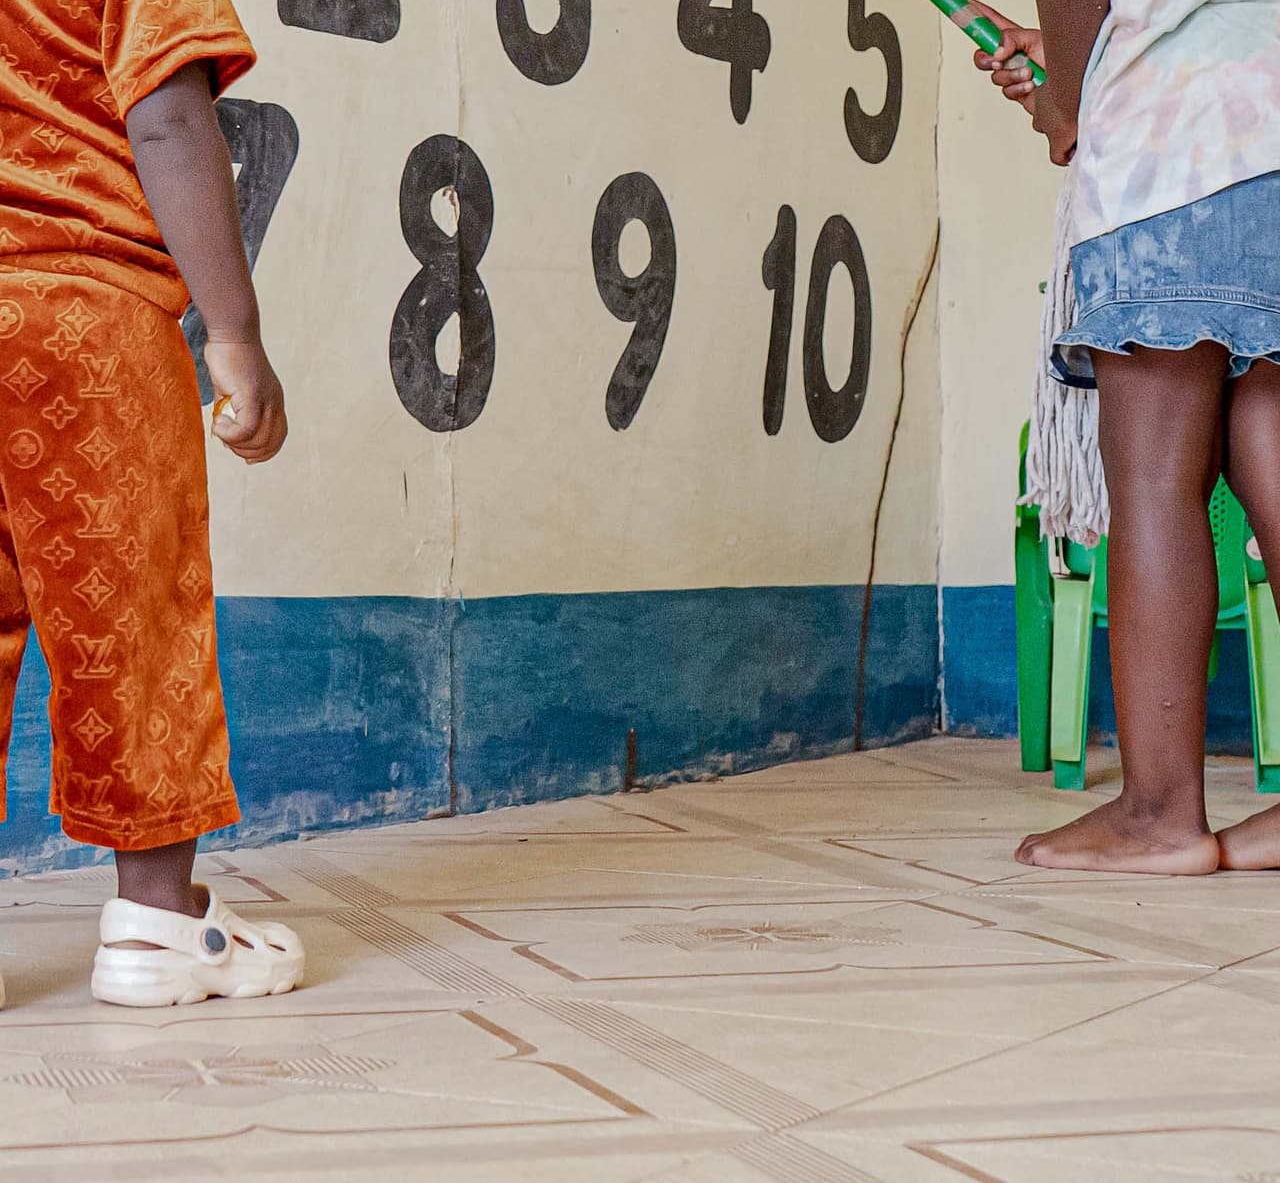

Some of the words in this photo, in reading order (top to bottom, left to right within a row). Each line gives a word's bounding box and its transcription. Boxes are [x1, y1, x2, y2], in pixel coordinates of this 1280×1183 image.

[389, 134, 495, 432] 8
[592, 172, 676, 431] 9
[762, 205, 872, 443] 10
